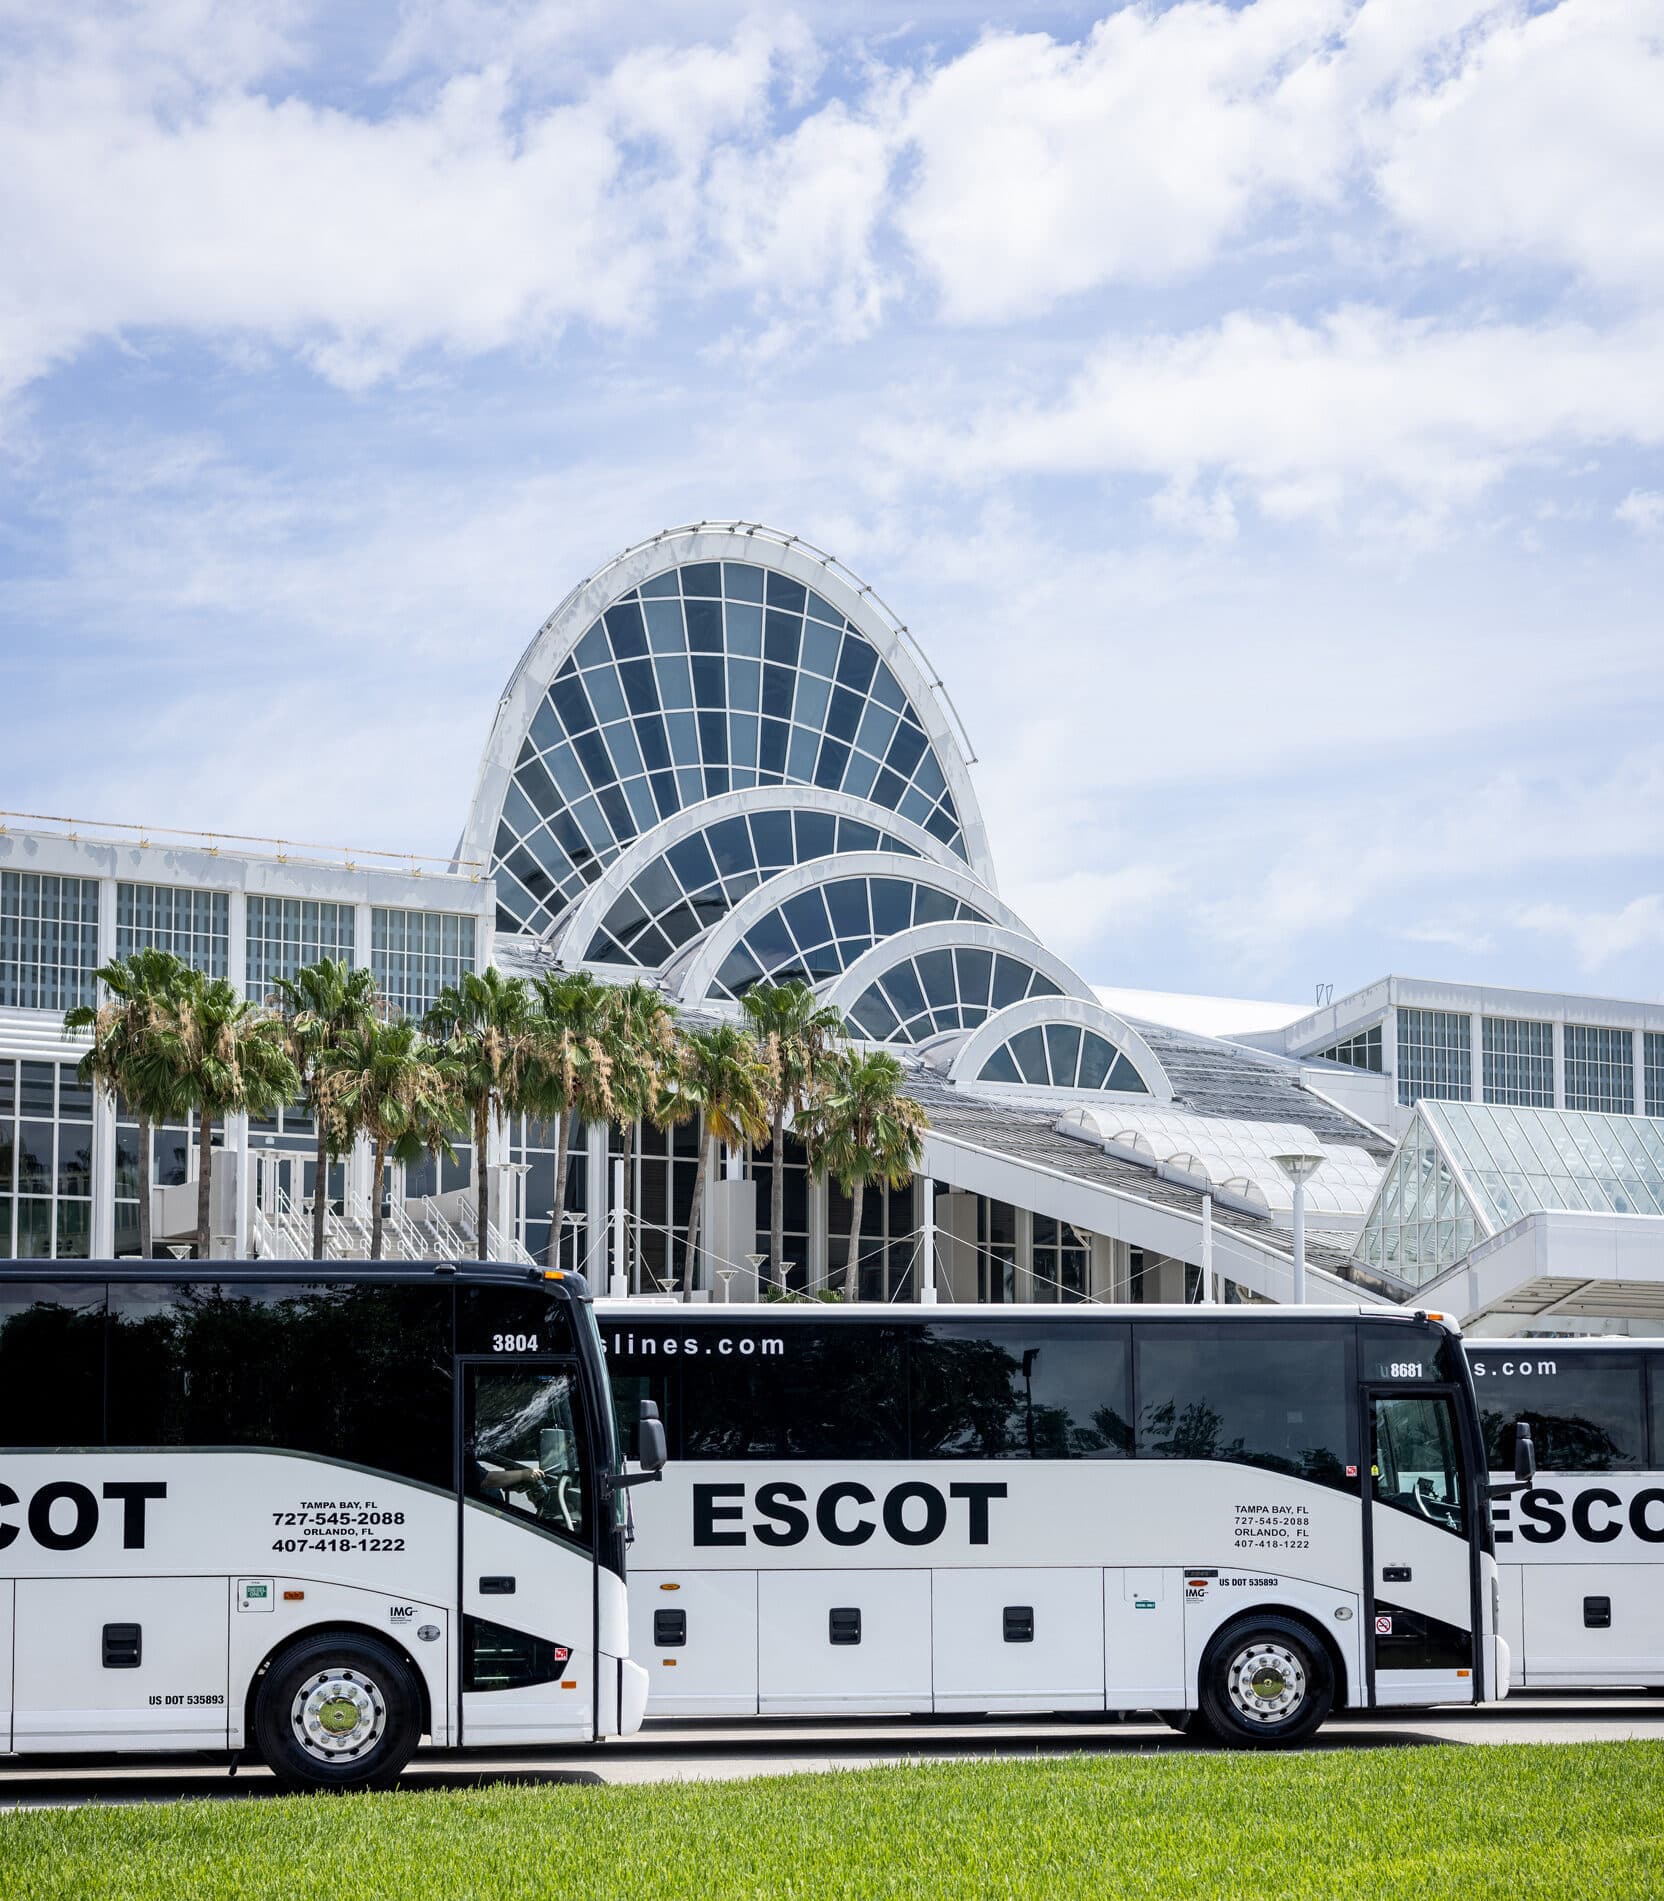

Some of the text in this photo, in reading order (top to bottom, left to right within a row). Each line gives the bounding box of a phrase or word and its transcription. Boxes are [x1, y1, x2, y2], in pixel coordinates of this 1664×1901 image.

[492, 1334, 539, 1352] 3804
[1390, 1362, 1423, 1378] 8681
[1473, 1360, 1557, 1376] s.com
[300, 1501, 378, 1510] TAMPA BAY, FL
[1234, 1505, 1309, 1515] TAMPA BAY, FL
[272, 1512, 405, 1526] 727-545-2088
[693, 1481, 1009, 1548] ESCOT
[1234, 1517, 1310, 1526] 727-545-2088
[303, 1528, 374, 1536] ORLANDO, FL
[1234, 1528, 1309, 1537] ORLANDO, FL
[272, 1538, 405, 1552] 407-418-1222
[1234, 1540, 1310, 1549] 407-418-1222
[1219, 1578, 1279, 1587] US DOT 535893
[1186, 1588, 1206, 1597] IMG
[390, 1606, 415, 1617] IMG
[148, 1695, 225, 1705] US DOT 535893
